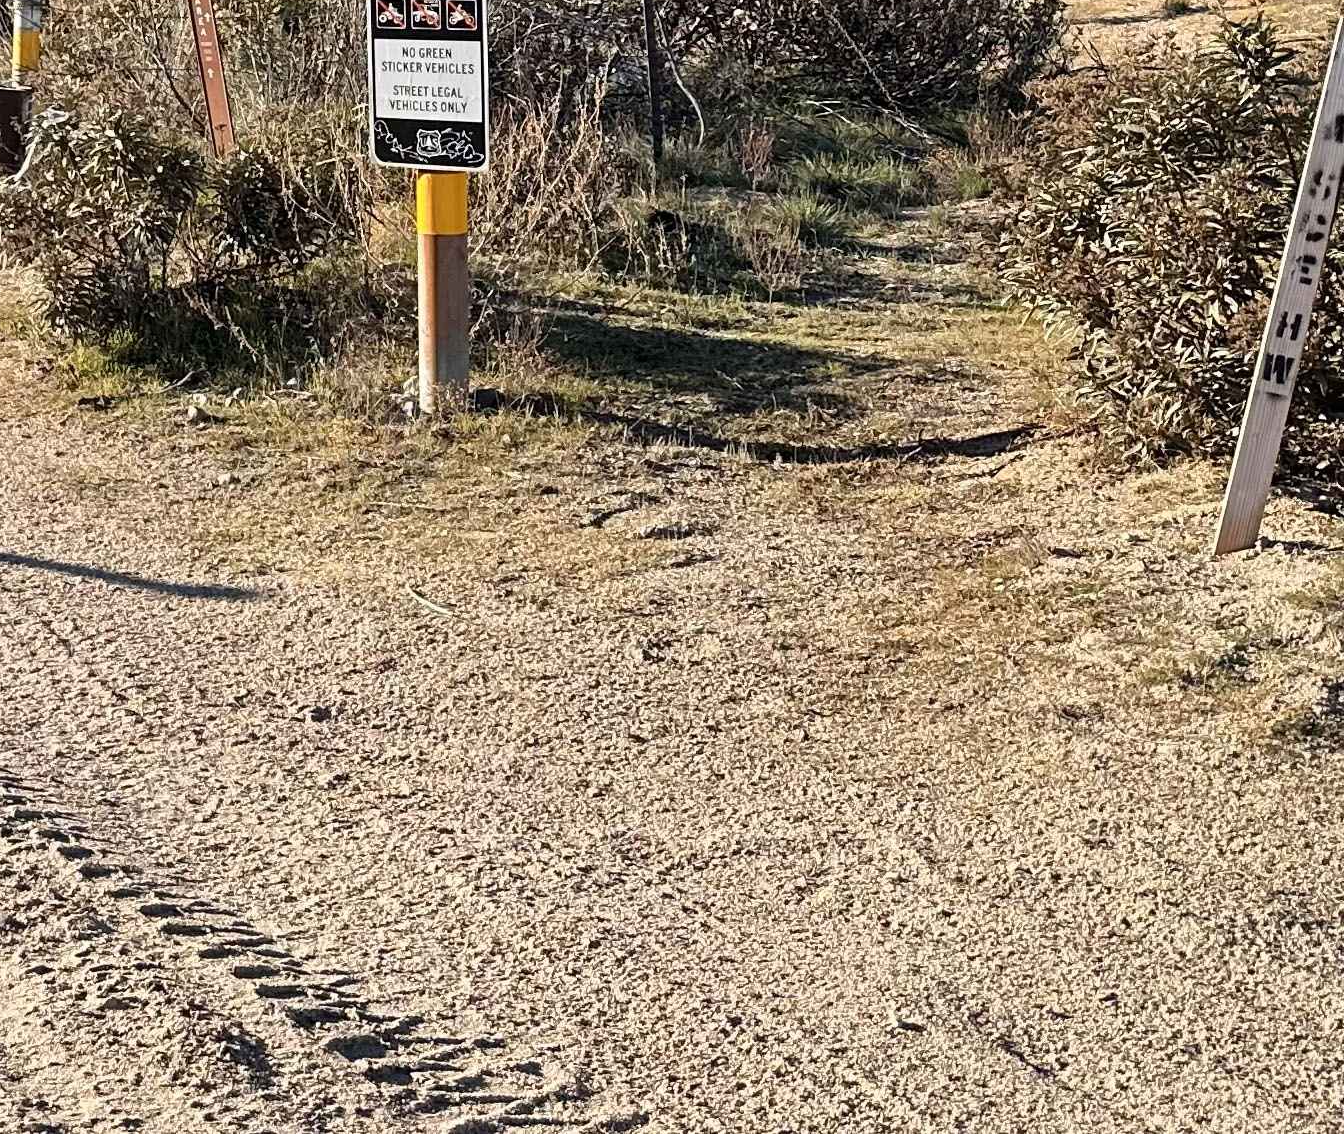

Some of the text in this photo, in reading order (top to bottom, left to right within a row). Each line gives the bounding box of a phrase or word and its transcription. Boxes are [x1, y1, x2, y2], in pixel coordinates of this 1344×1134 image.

[402, 47, 452, 59] NO GREEN
[382, 61, 475, 75] STICKER VEHICLES
[393, 85, 464, 98] STREET LEGAL
[390, 100, 468, 113] VEHICLES ONLY
